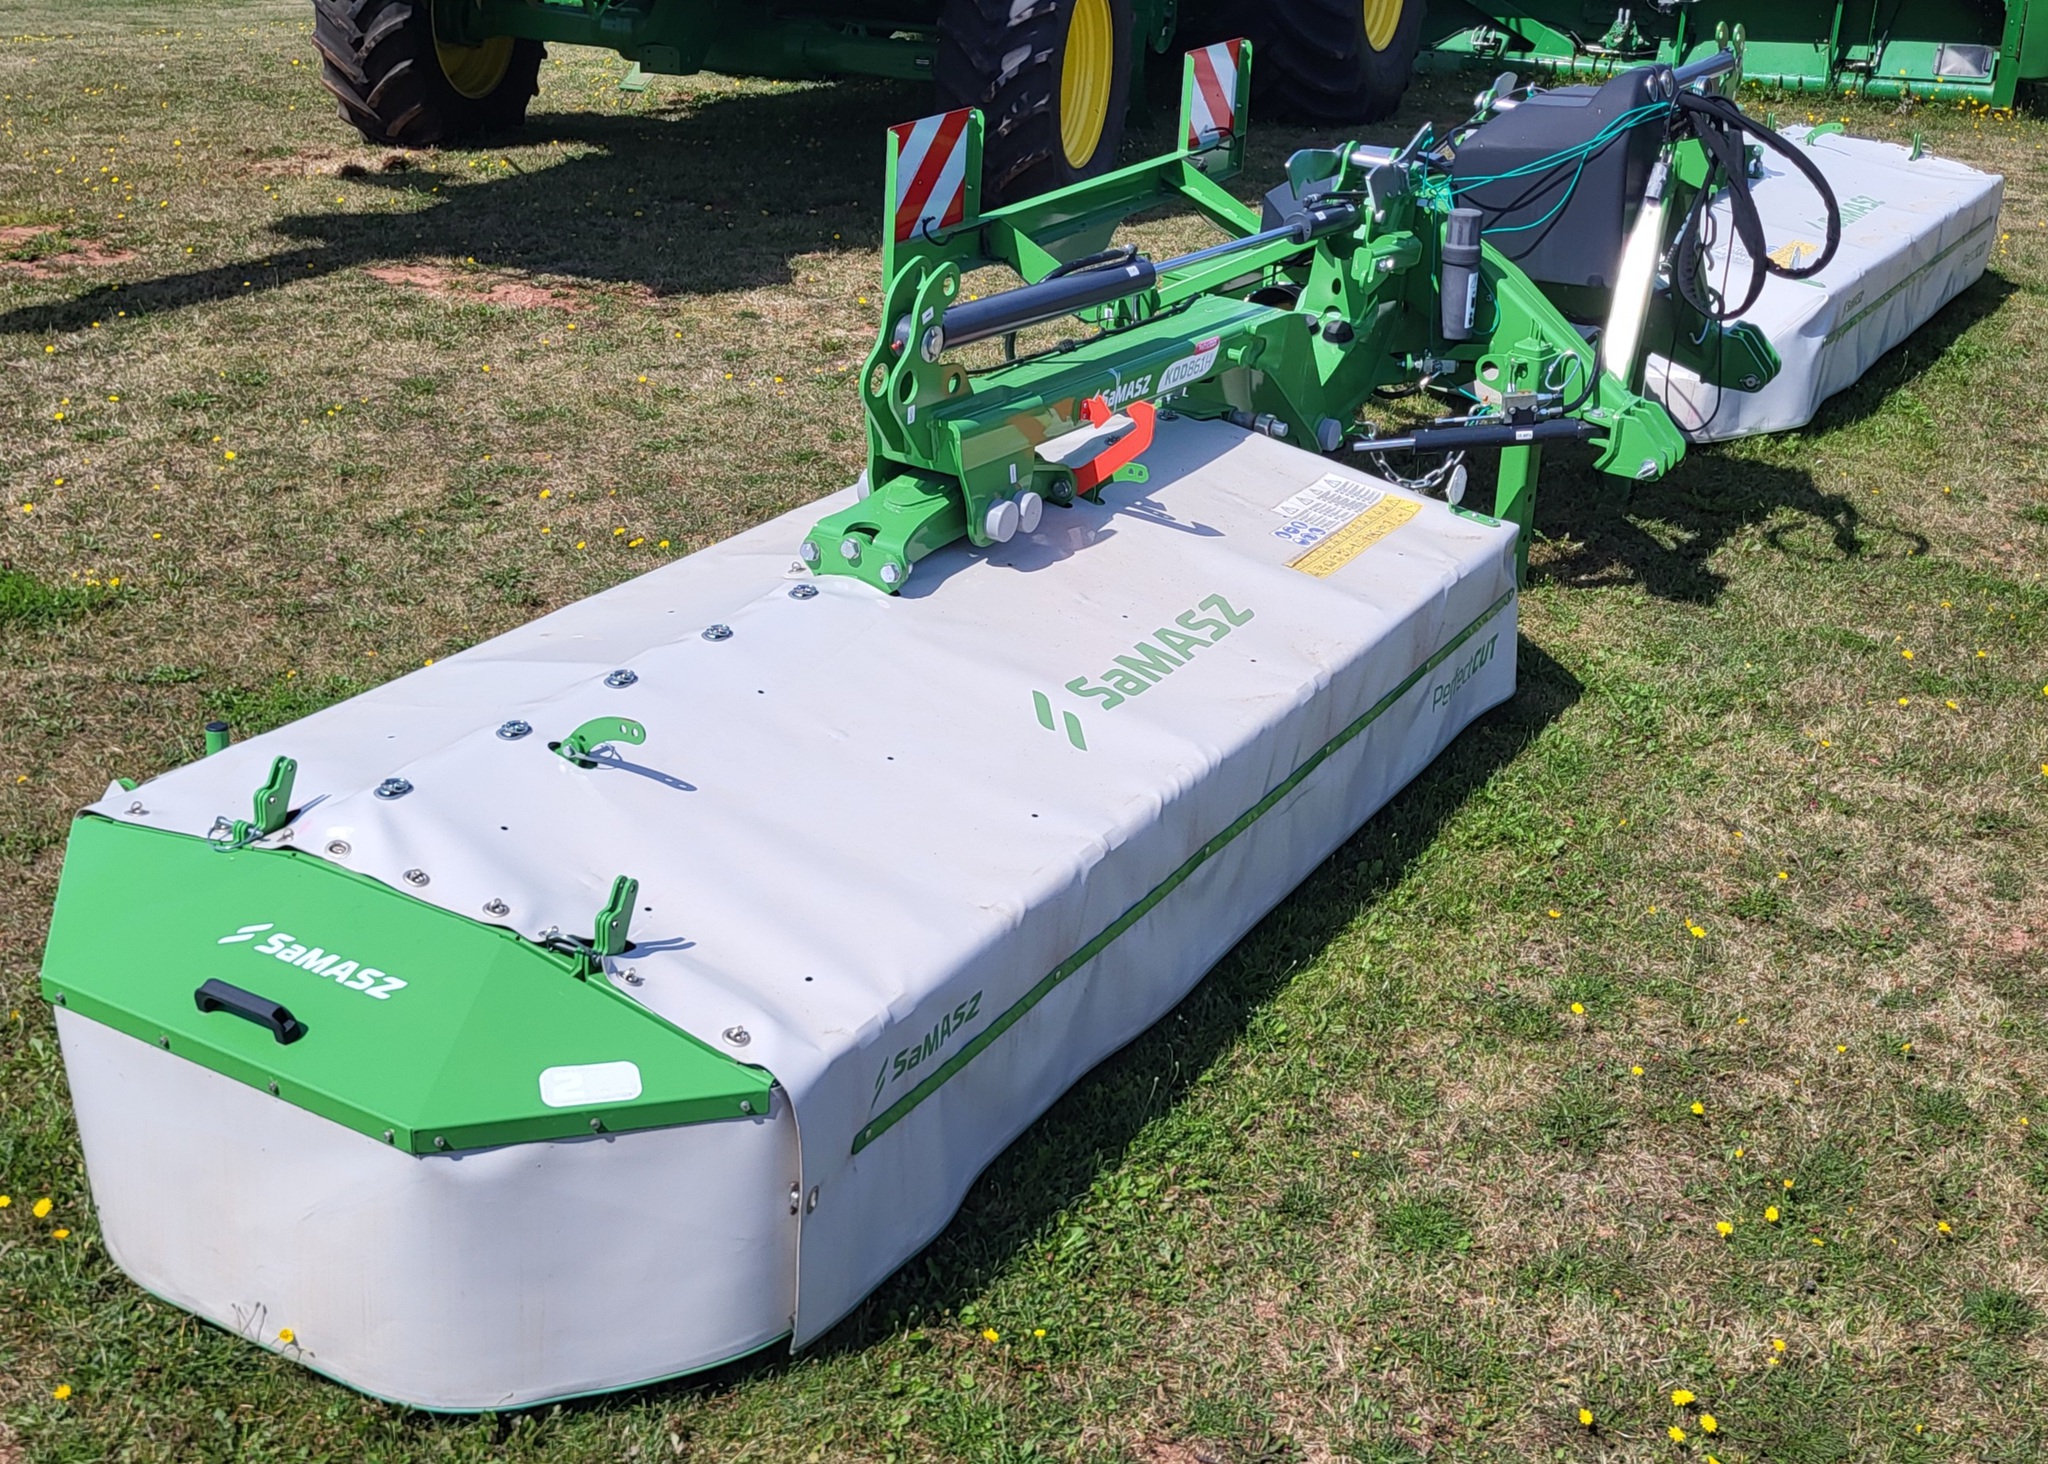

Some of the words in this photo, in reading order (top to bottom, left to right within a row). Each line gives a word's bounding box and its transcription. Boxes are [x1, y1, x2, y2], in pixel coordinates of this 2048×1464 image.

[1101, 373, 1153, 408] SaMASZ
[1163, 352, 1214, 387] KDD861H
[1063, 592, 1256, 712] SaMASZ
[1432, 631, 1500, 714] PerfectCUT
[252, 931, 409, 1001] SaMASZ
[890, 989, 984, 1084] SaMASZ
